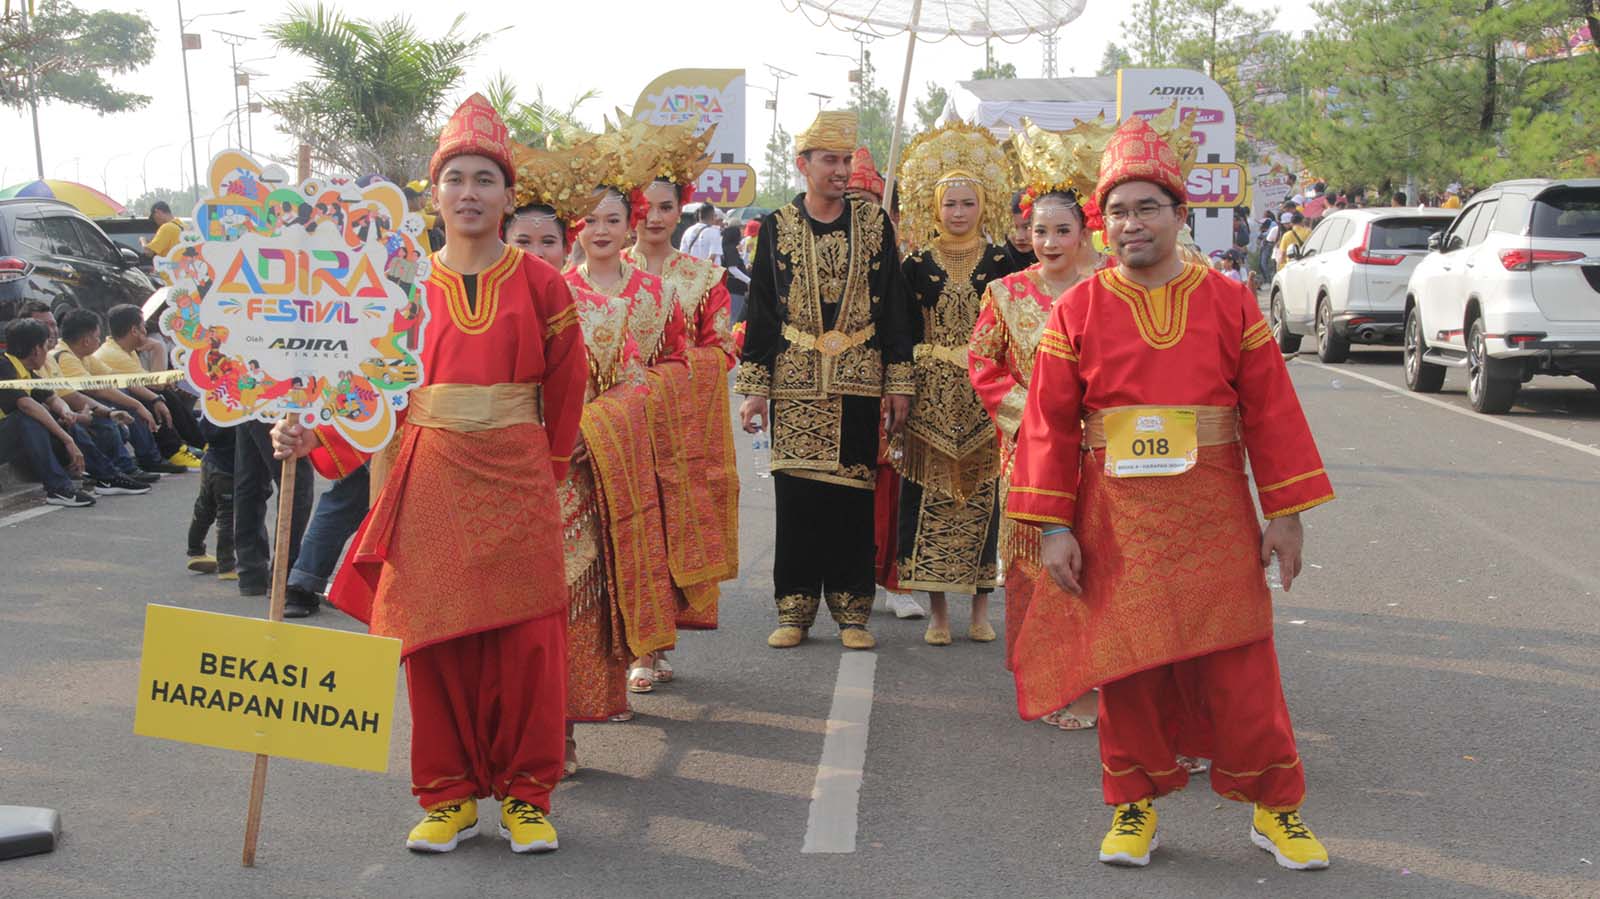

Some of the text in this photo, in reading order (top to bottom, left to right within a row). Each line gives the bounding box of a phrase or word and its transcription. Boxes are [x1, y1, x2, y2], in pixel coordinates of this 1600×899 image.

[1150, 86, 1205, 96] ADIRA
[660, 94, 724, 113] ADIRA
[698, 169, 748, 193] RT
[1187, 168, 1240, 196] SH
[216, 247, 389, 298] ADIRA
[246, 298, 360, 325] FESTIVAL
[246, 335, 349, 351] Oleh ADIRA
[285, 351, 349, 359] FINANCE
[1132, 438, 1169, 456] 018
[200, 652, 337, 693] BEKASI 4
[151, 679, 380, 734] HARAPAN INDAH
